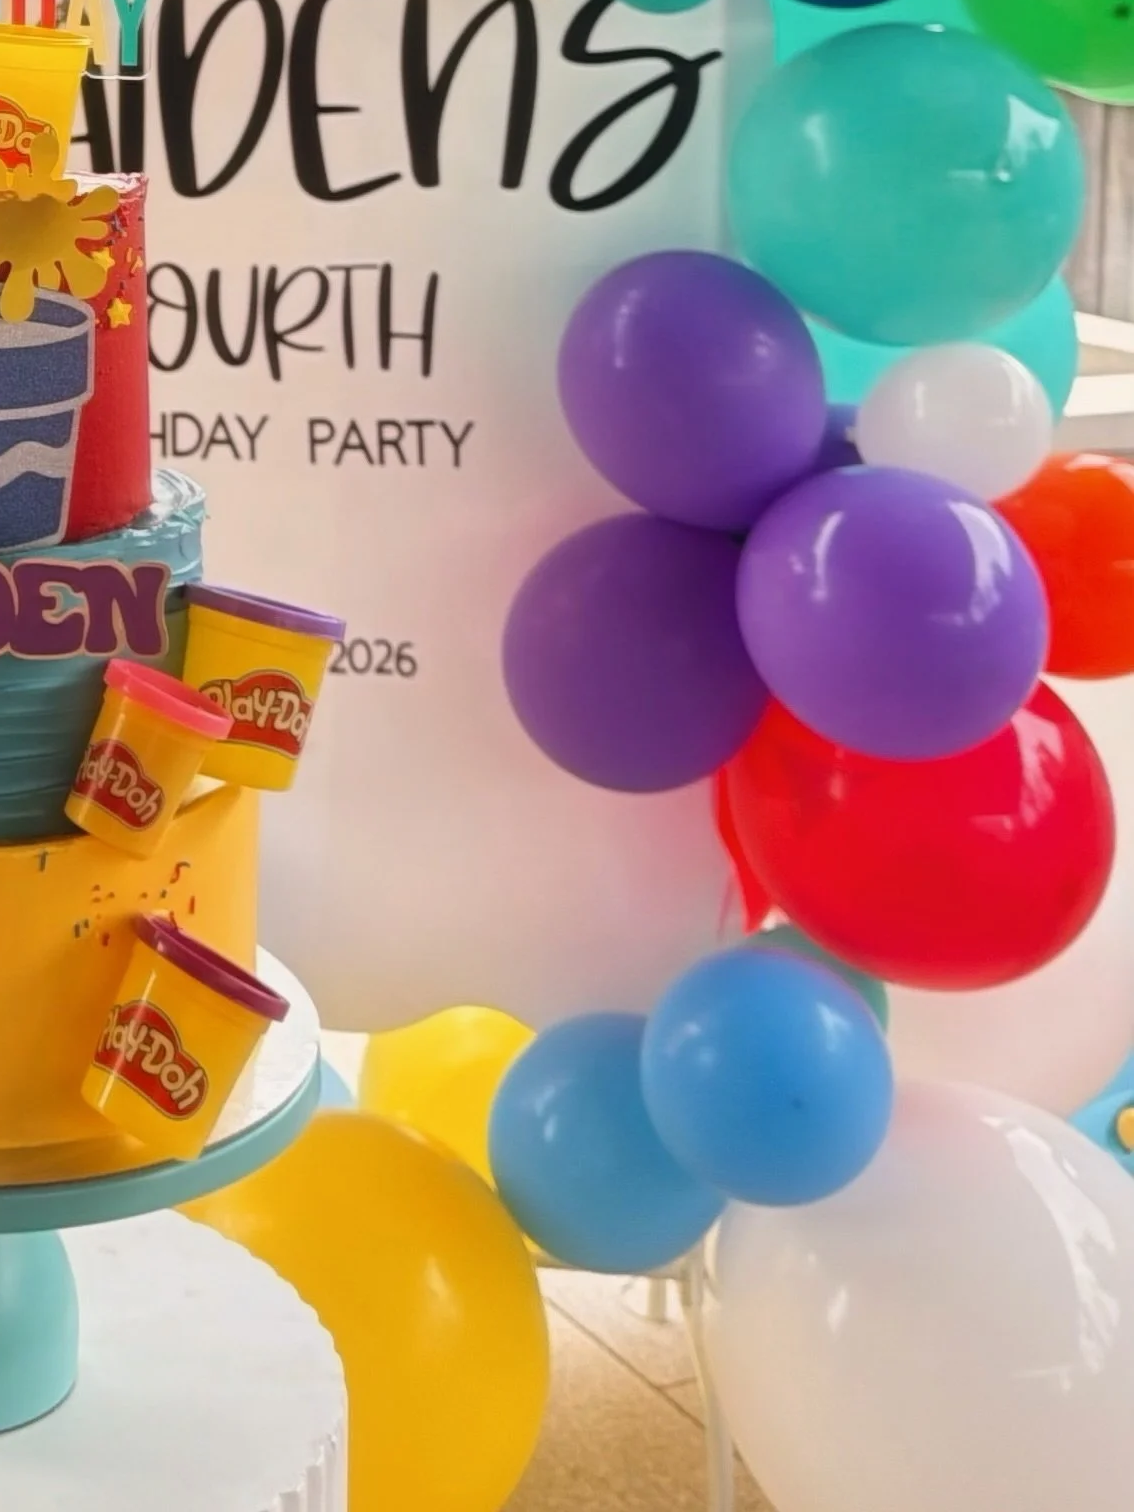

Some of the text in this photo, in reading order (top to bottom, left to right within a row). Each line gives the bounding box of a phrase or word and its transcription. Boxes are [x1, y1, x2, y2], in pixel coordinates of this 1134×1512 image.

[146, 261, 439, 382] OURTH
[150, 410, 474, 468] HDAY PARTY
[329, 637, 418, 679] 2026
